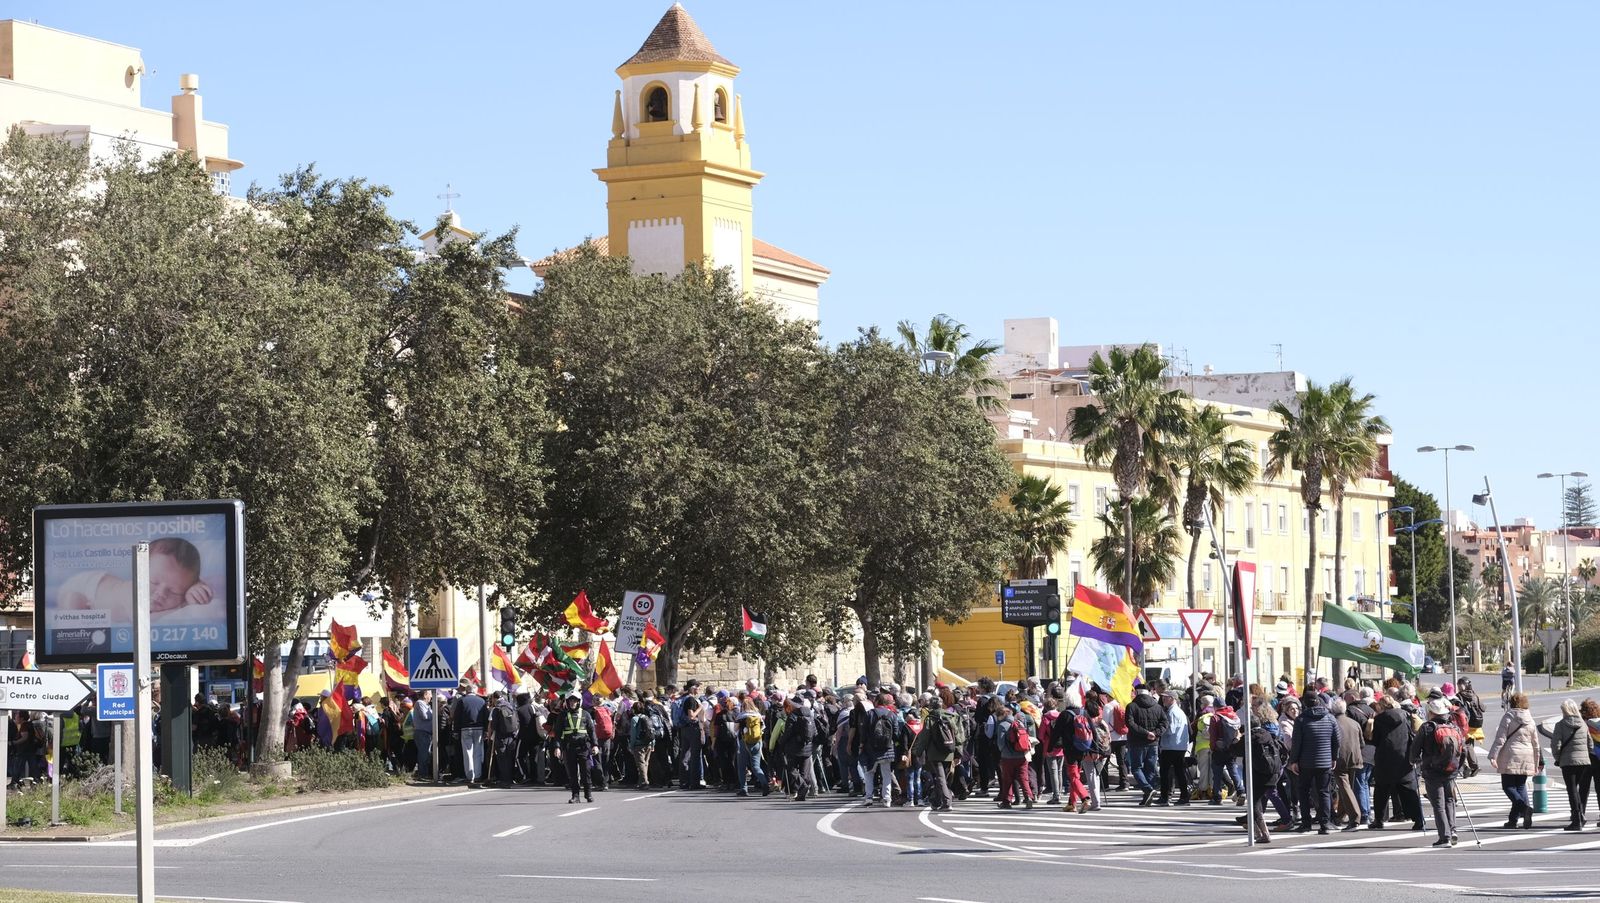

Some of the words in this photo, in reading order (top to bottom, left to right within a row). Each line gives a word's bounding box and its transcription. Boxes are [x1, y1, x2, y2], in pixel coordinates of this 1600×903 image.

[51, 521, 69, 538] Lo
[73, 519, 144, 537] hacemos
[148, 516, 205, 538] posible
[113, 547, 133, 559] Lópe
[637, 601, 650, 609] 50
[81, 613, 106, 621] hospital
[622, 620, 657, 628] CONTROLA
[163, 628, 188, 641] 217
[191, 627, 218, 641] 140
[0, 676, 42, 685] LMERIA
